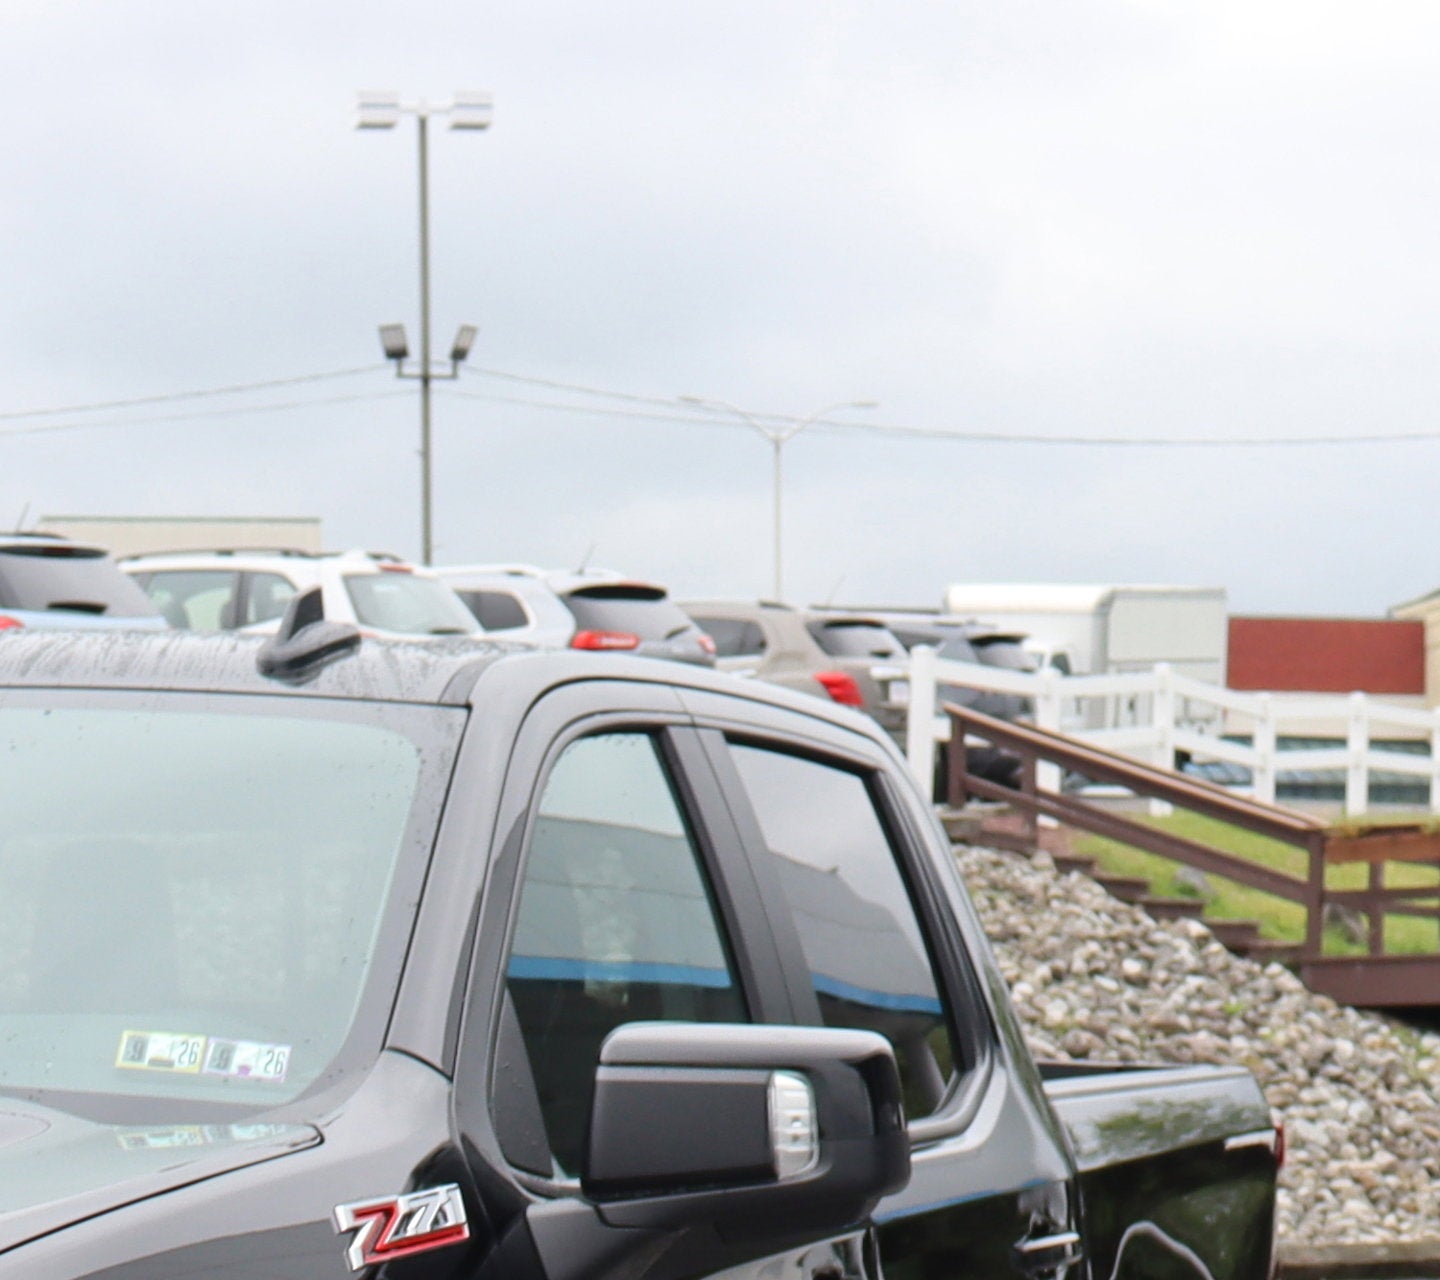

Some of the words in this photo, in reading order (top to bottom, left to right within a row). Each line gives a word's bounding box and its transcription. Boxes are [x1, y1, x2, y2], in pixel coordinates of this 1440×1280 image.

[177, 1039, 200, 1065] 26
[263, 1048, 286, 1075] 26
[332, 1182, 471, 1273] Z71
